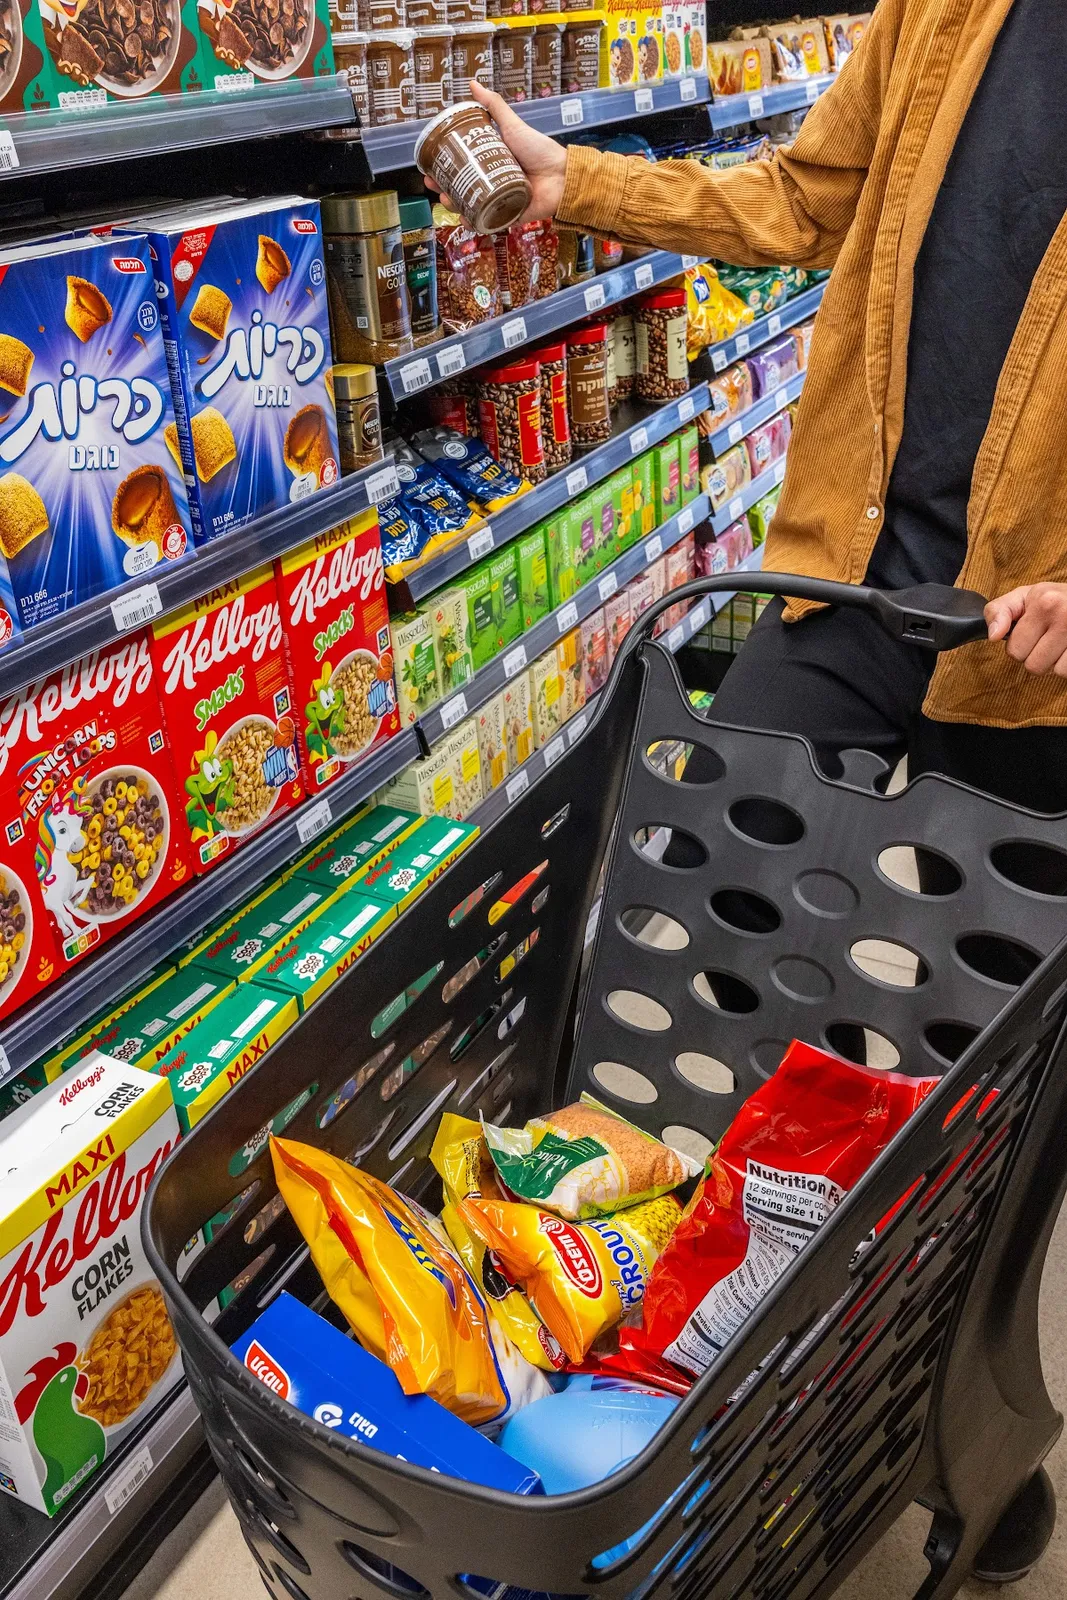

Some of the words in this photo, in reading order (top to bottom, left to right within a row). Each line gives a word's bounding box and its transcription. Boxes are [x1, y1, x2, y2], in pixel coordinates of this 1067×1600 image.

[386, 275, 406, 290] GOLD
[254, 385, 292, 408] נוגט
[69, 445, 120, 470] נוגט
[313, 521, 353, 553] MAXI
[368, 681, 385, 710] WIN
[24, 721, 98, 791] UNICORN
[263, 747, 286, 780] WIN
[26, 759, 71, 818] FROOT
[72, 730, 117, 768] LOOPS
[299, 955, 317, 974] COCO
[336, 935, 373, 977] MAXI
[183, 1064, 205, 1086] COCO
[226, 1034, 270, 1087] MAXI
[59, 1066, 106, 1106] Kellogg's
[94, 1082, 134, 1117] CORN
[107, 1086, 145, 1118] FLAKES
[45, 1133, 116, 1209] MAXI
[748, 1162, 827, 1194] Nutrition
[746, 1192, 782, 1212] Serving
[785, 1203, 807, 1217] size
[749, 1181, 760, 1192] 12
[761, 1184, 798, 1205] servings
[798, 1194, 814, 1208] per
[746, 1218, 800, 1254] Calories
[772, 1223, 784, 1234] per
[786, 1228, 812, 1242] servin
[71, 1235, 130, 1303] CORN
[558, 1235, 595, 1283] OSEM
[76, 1257, 134, 1321] FLAKES
[725, 1275, 735, 1292] Total
[695, 1310, 713, 1336] Protein
[709, 1315, 732, 1338] Includes
[713, 1298, 725, 1314] Total
[722, 1311, 740, 1329] Sugar
[347, 1411, 379, 1438] נוגט
